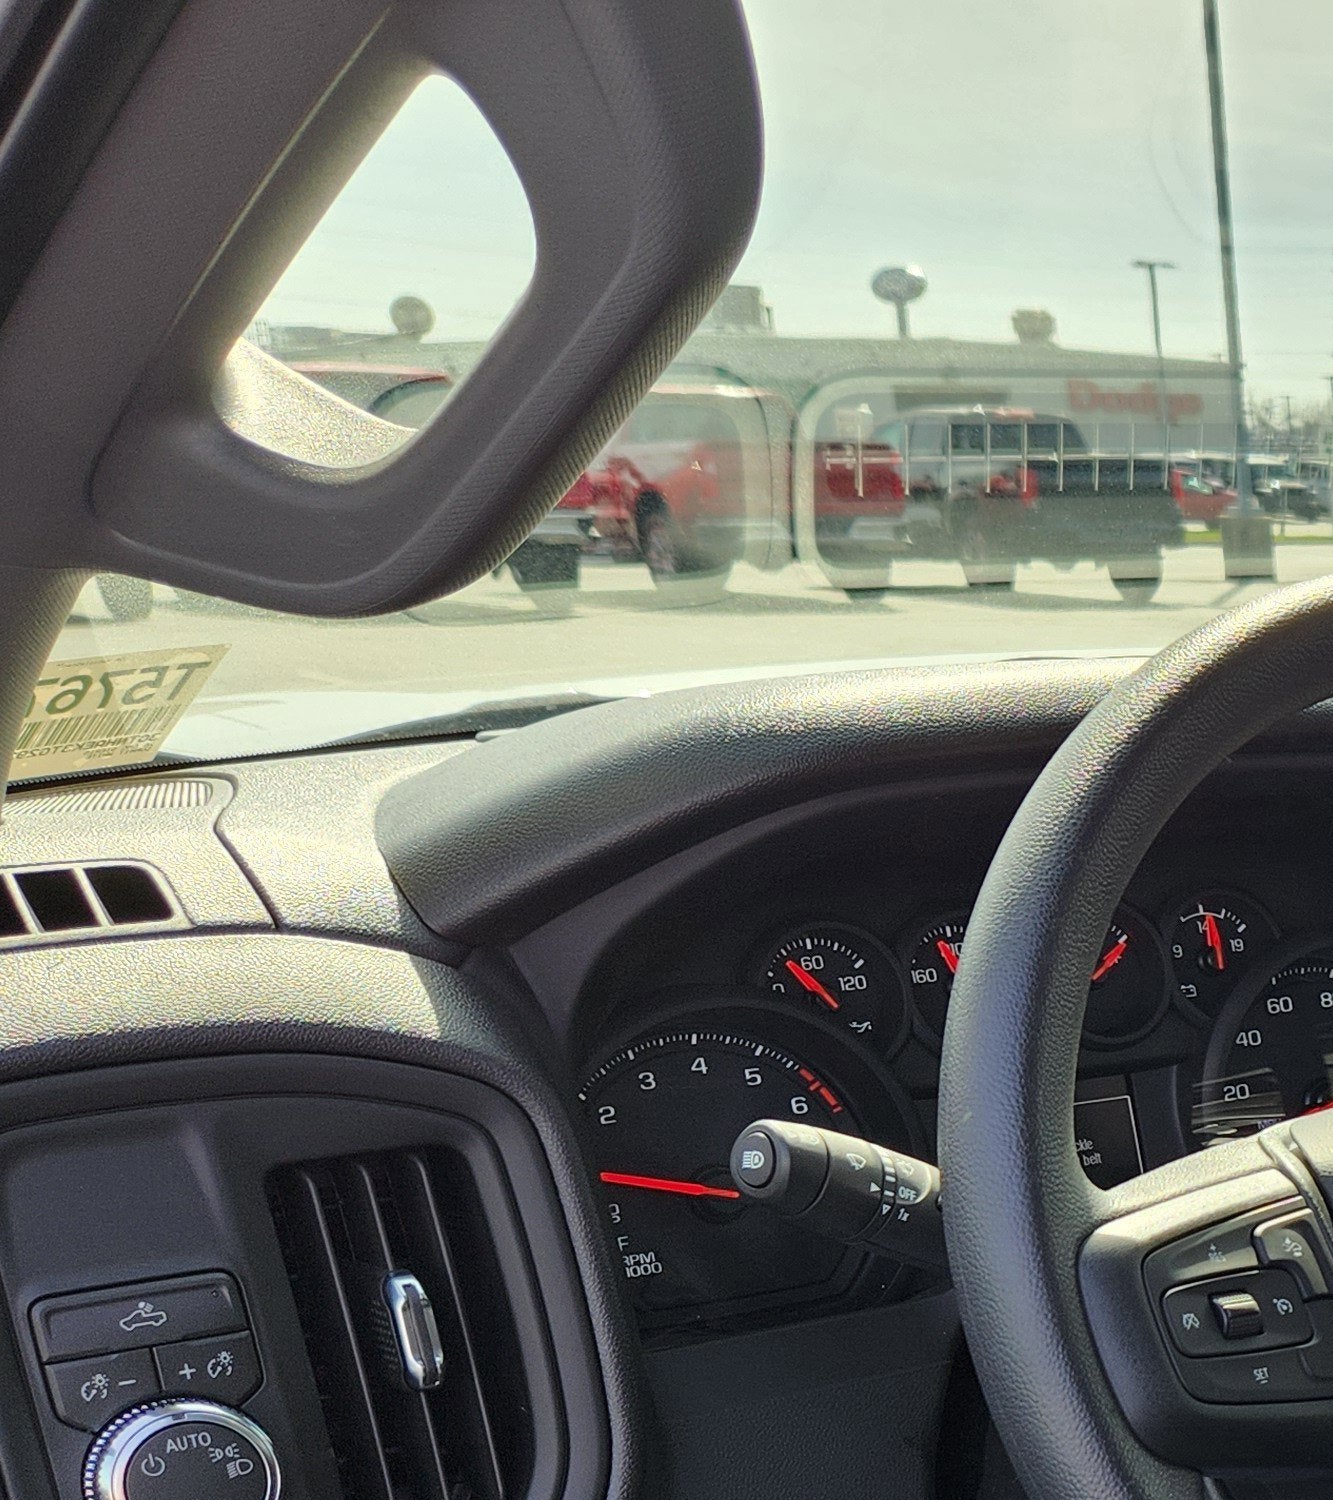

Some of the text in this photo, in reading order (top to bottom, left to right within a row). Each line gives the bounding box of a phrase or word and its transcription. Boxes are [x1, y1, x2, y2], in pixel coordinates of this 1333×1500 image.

[1172, 945, 1183, 958] 9
[1230, 938, 1244, 952] 19
[800, 955, 824, 971] 60
[838, 975, 867, 991] 120
[911, 968, 938, 984] 160
[1266, 997, 1293, 1014] 60
[1235, 1030, 1262, 1047] 40
[691, 1057, 708, 1075] 4
[638, 1072, 656, 1090] 3
[744, 1067, 762, 1086] 5
[1223, 1084, 1250, 1102] 20
[790, 1096, 809, 1115] 6
[598, 1106, 617, 1125] 2
[1083, 1153, 1101, 1166] belt
[898, 1186, 918, 1200] OFF
[1254, 1367, 1269, 1381] SET
[166, 1432, 212, 1454] AUTO
